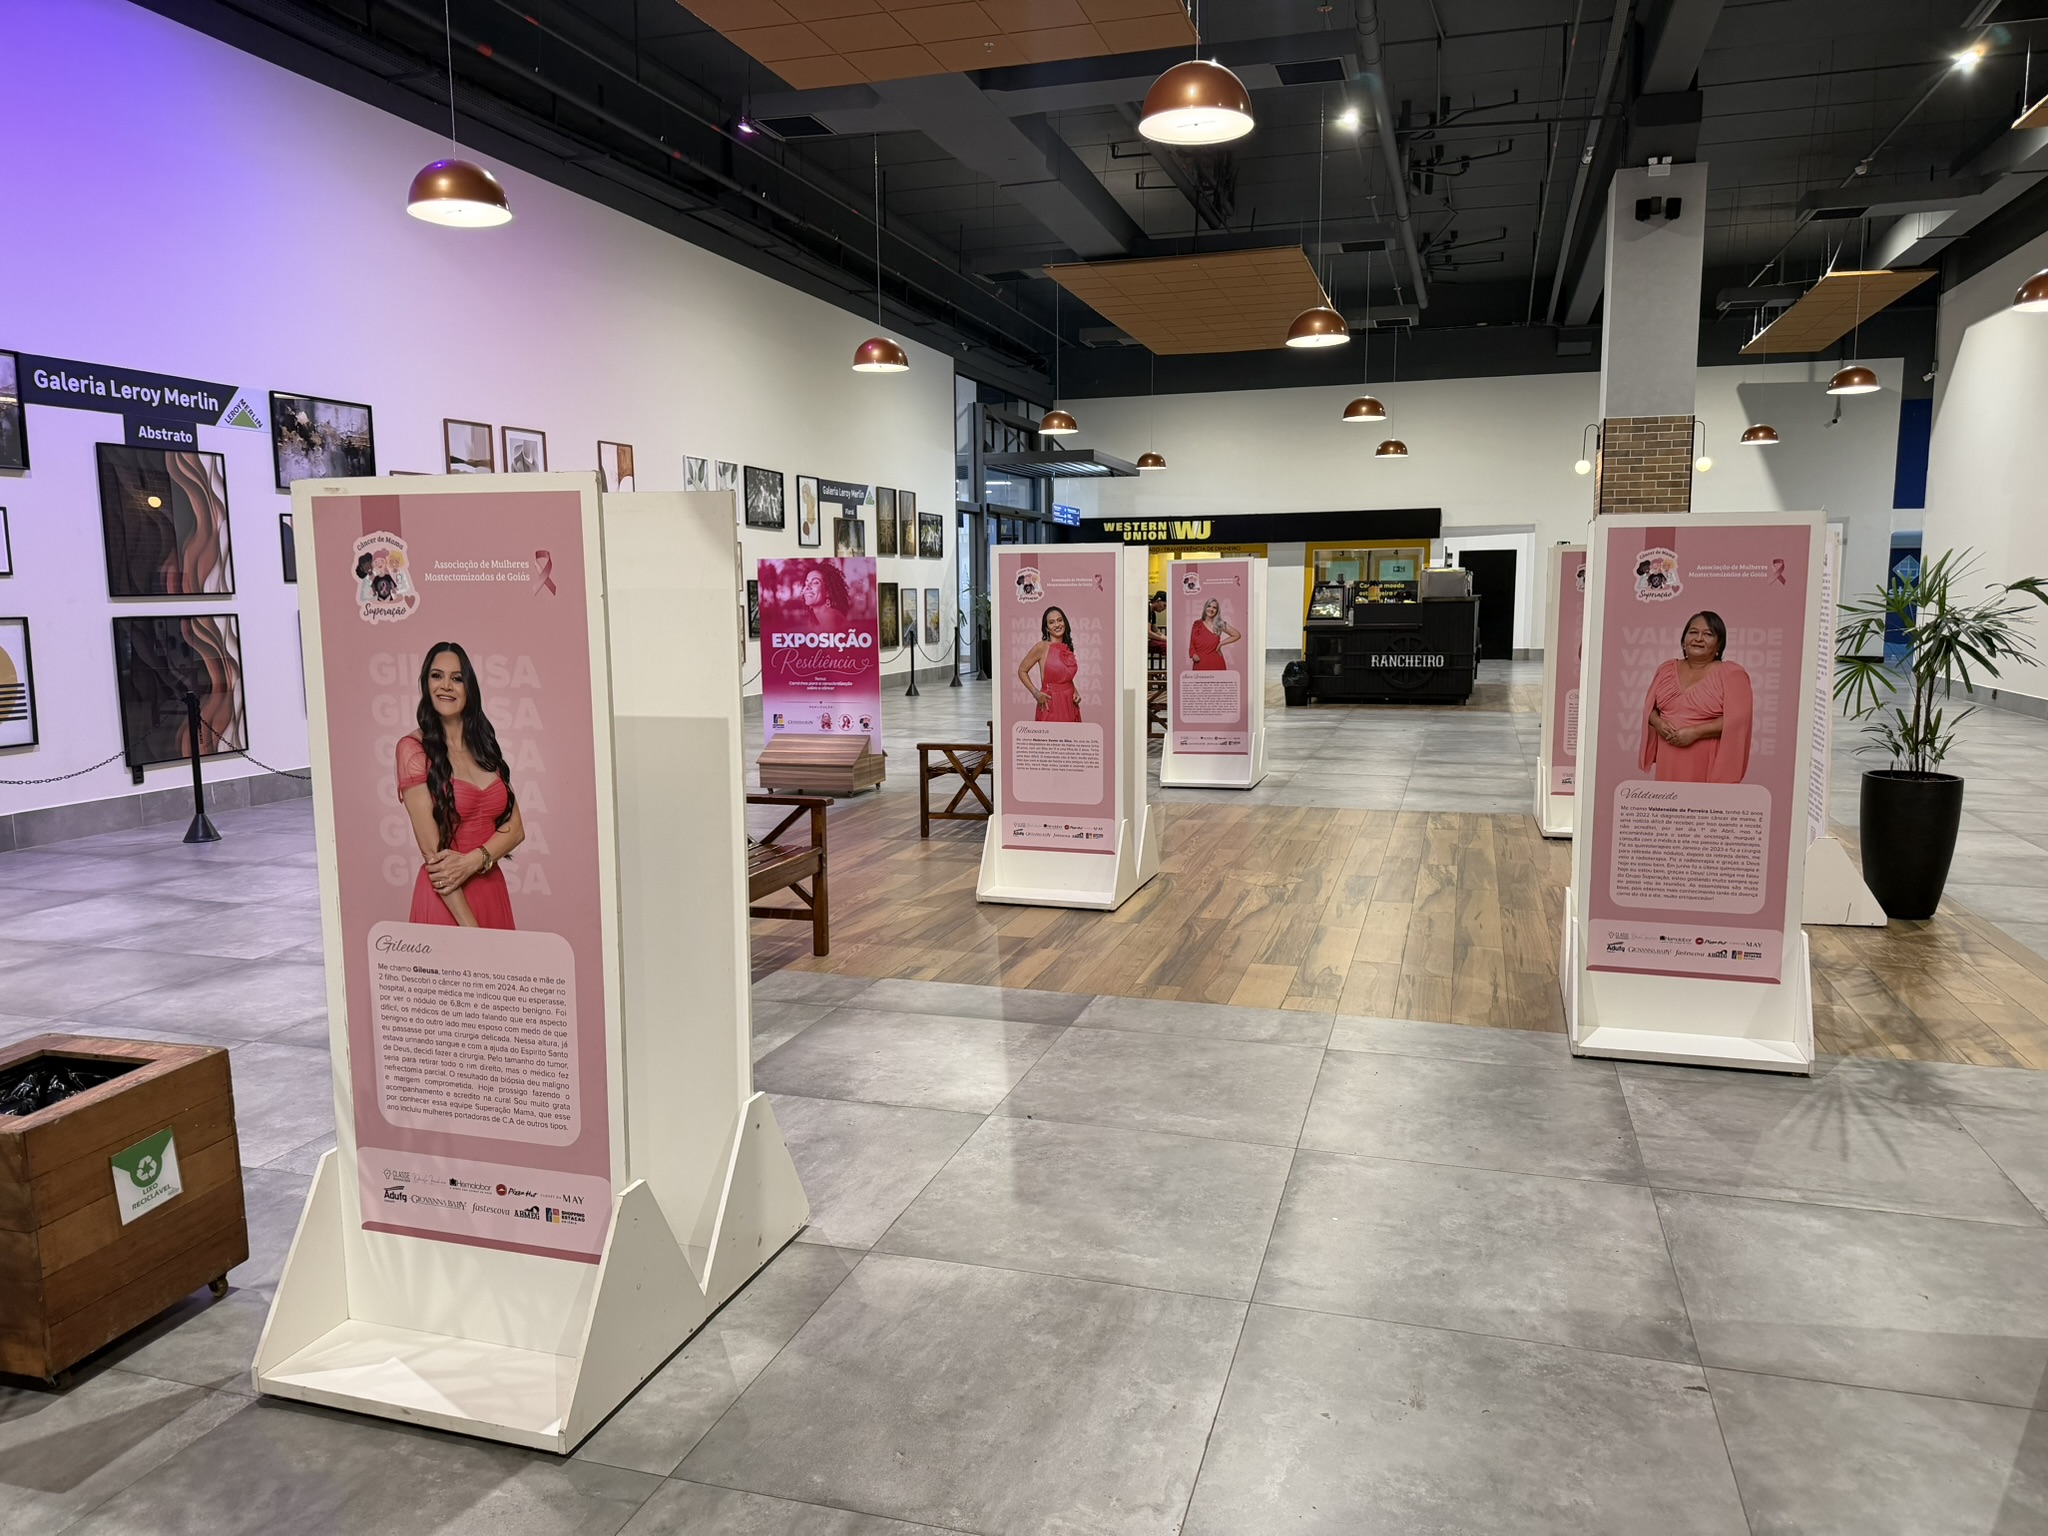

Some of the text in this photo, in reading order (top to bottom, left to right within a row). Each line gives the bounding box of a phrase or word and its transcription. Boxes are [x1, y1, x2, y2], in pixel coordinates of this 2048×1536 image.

[34, 370, 219, 412] Galeria Leroy Merlin
[224, 398, 263, 428] LEROY MERLIN
[138, 426, 192, 443] Abstrato
[822, 486, 838, 496] Galeria
[851, 490, 864, 498] Merlin
[1104, 522, 1167, 531] WESTERN
[1123, 531, 1167, 540] UNION
[1172, 520, 1212, 540] WU
[357, 537, 376, 551] Câncer
[386, 536, 404, 550] Mama
[434, 560, 529, 570] Associação de Mulheres
[425, 572, 530, 581] Mastectomizadas de Goiás
[1639, 590, 1672, 600] Superação
[364, 603, 406, 620] Superação
[772, 628, 872, 652] EXPOSIÇÃO
[771, 648, 874, 676] Resiliência
[1371, 654, 1444, 667] RANCHEIRO
[1620, 788, 1678, 800] Valdineide
[375, 934, 432, 954] Gileusa
[377, 962, 388, 970] Me
[389, 964, 411, 972] chamo
[412, 965, 440, 975] Gileusa,
[441, 968, 461, 976] tenho
[462, 969, 471, 977] 43
[506, 974, 531, 982] casada
[539, 975, 554, 984] mãe
[555, 977, 565, 985] de
[378, 972, 383, 980] 2
[384, 973, 399, 981] filho.
[401, 974, 430, 984] Descobri
[437, 977, 460, 987] câncer
[497, 982, 517, 991] 2024.
[518, 984, 529, 992] Ao
[530, 985, 554, 995] chegar
[378, 983, 406, 992] hospital,
[413, 987, 436, 996] equipe
[437, 988, 462, 997] médica
[502, 995, 516, 1003] que
[528, 997, 566, 1007] esperasse,
[413, 996, 436, 1005] nódulo
[449, 999, 471, 1008] 6,8cm
[480, 1002, 490, 1010] de
[492, 1003, 519, 1013] aspecto
[522, 1005, 552, 1016] benigno.
[555, 1008, 566, 1016] Foi
[410, 1006, 439, 1015] médicos
[464, 1011, 479, 1019] lado
[539, 1018, 567, 1027] aspecto
[131, 1184, 172, 1210] RECICLÁVEL
[142, 1182, 158, 1195] LIXO
[508, 1188, 524, 1196] Pizza
[563, 1194, 584, 1204] MAY
[384, 1190, 540, 1220] Adufg GIOVANNA BABY fastescova ABMEG
